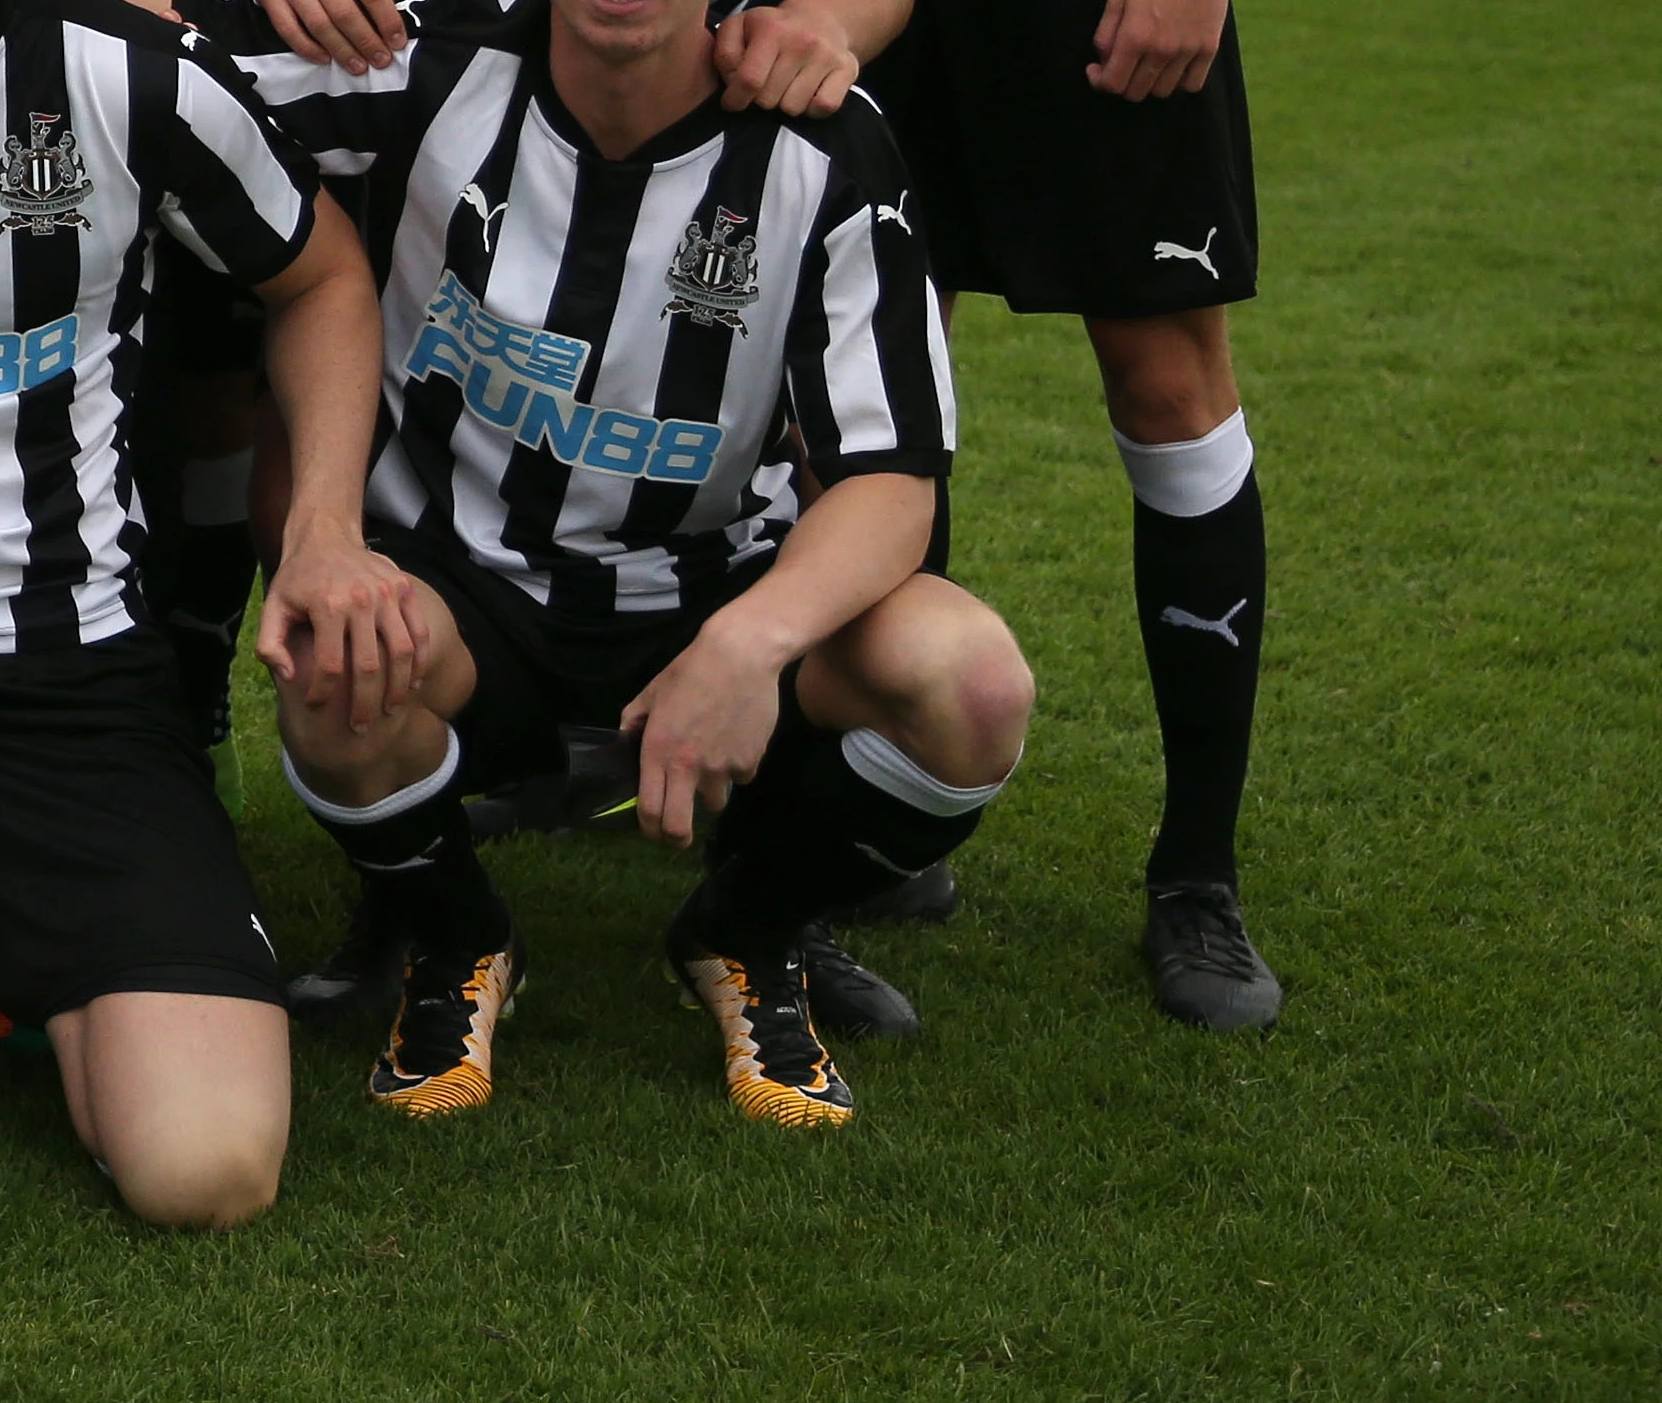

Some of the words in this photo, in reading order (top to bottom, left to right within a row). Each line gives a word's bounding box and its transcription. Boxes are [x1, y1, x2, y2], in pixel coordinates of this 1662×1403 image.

[5, 198, 51, 210] NEWCASTLE
[53, 196, 81, 208] UNITED
[428, 274, 589, 393] 乐天堂
[406, 324, 724, 483] FUN88
